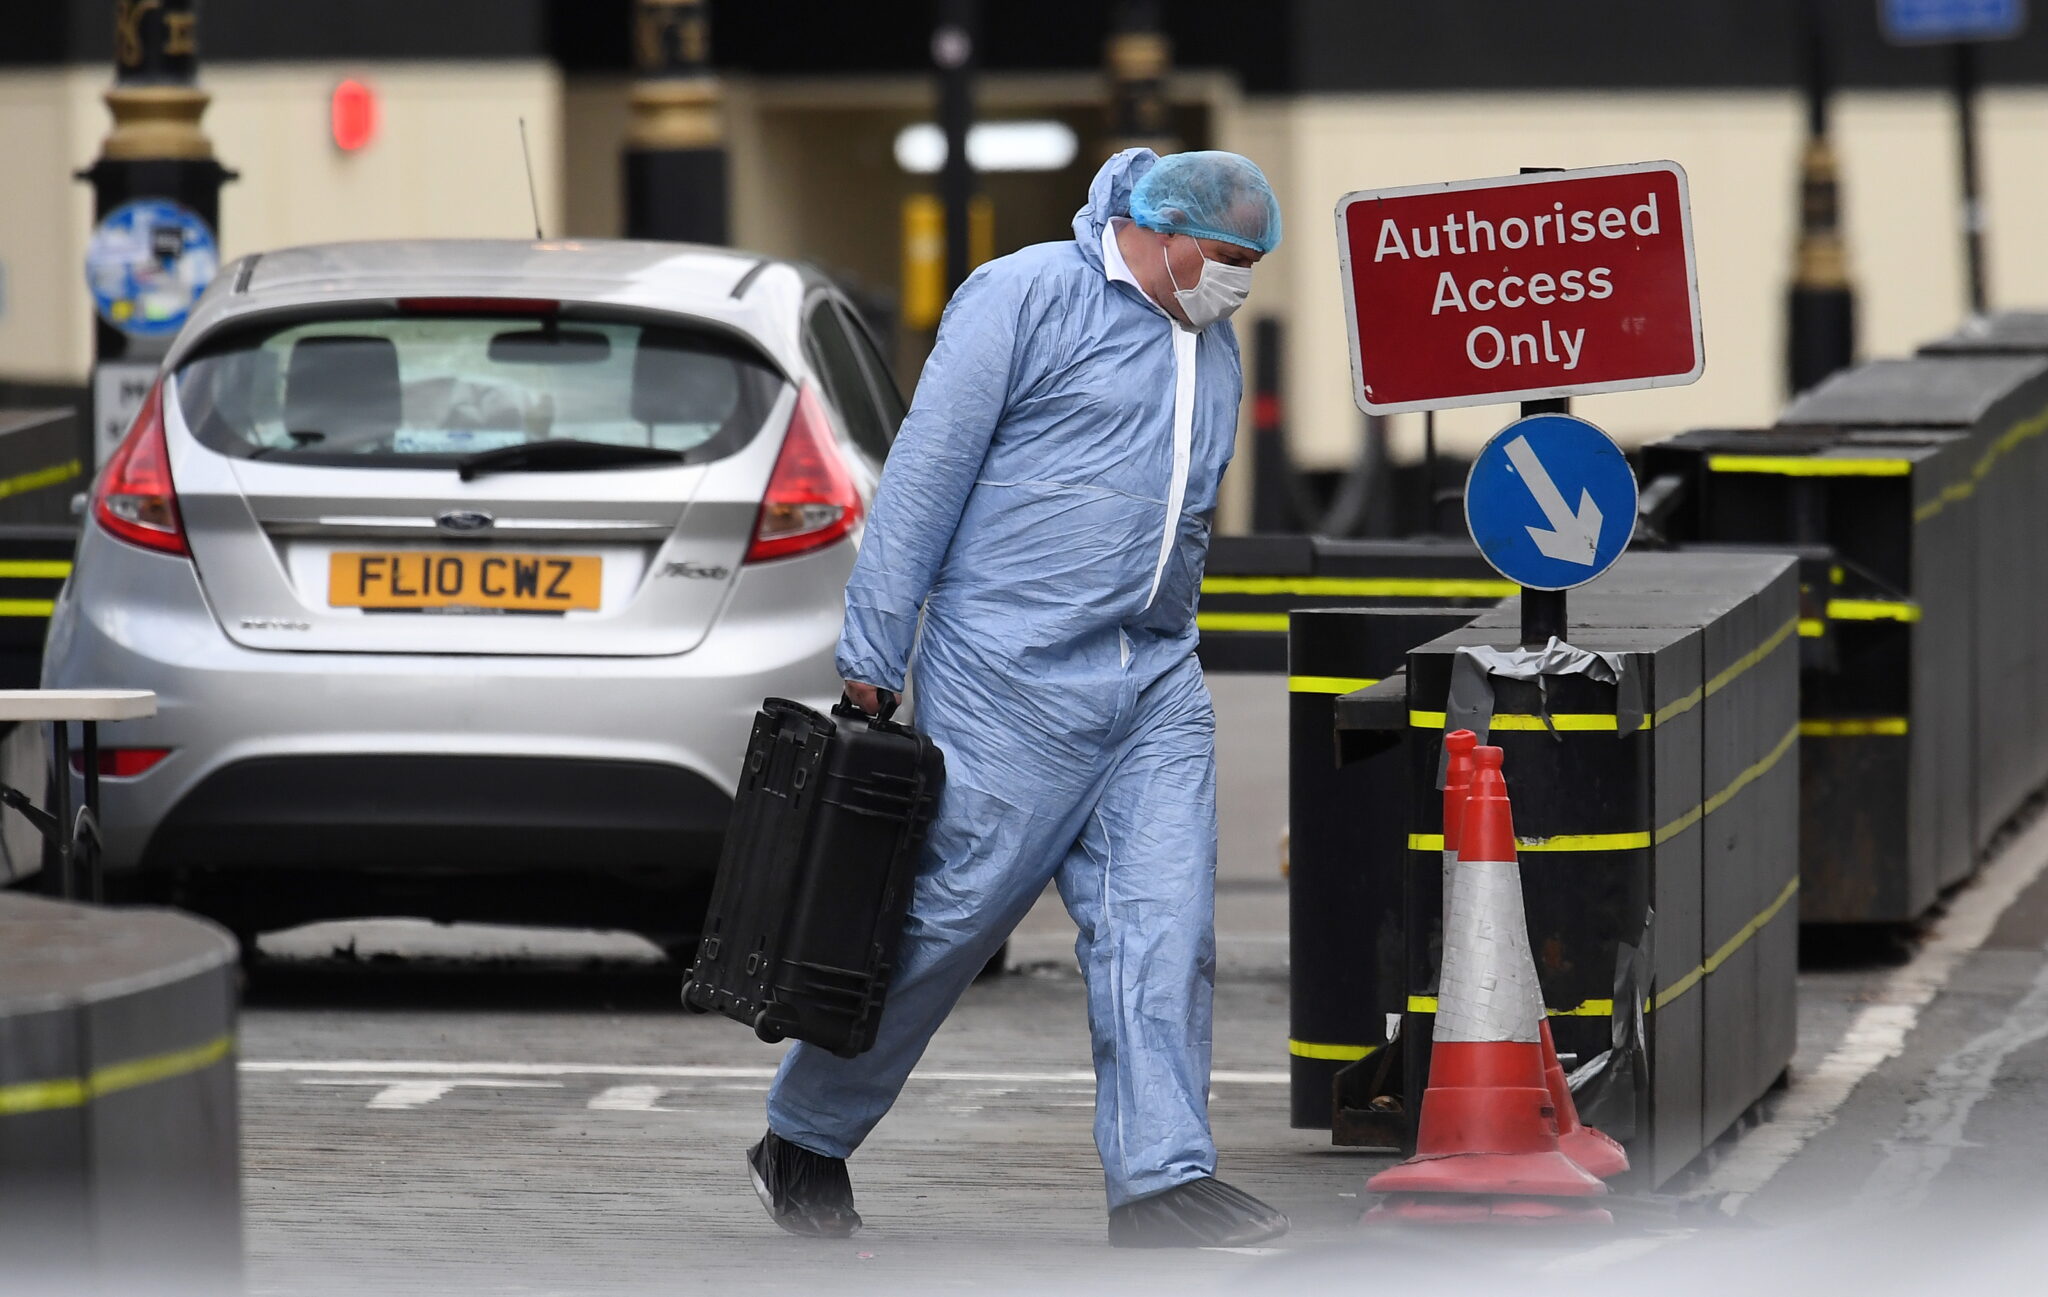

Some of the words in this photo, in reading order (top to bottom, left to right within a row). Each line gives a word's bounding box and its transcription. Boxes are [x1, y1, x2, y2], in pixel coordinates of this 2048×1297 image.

[1373, 192, 1660, 263] Authorised
[1431, 267, 1614, 315] Access
[1466, 320, 1586, 370] Only
[357, 555, 465, 597] FL10
[480, 556, 573, 600] CWZ
